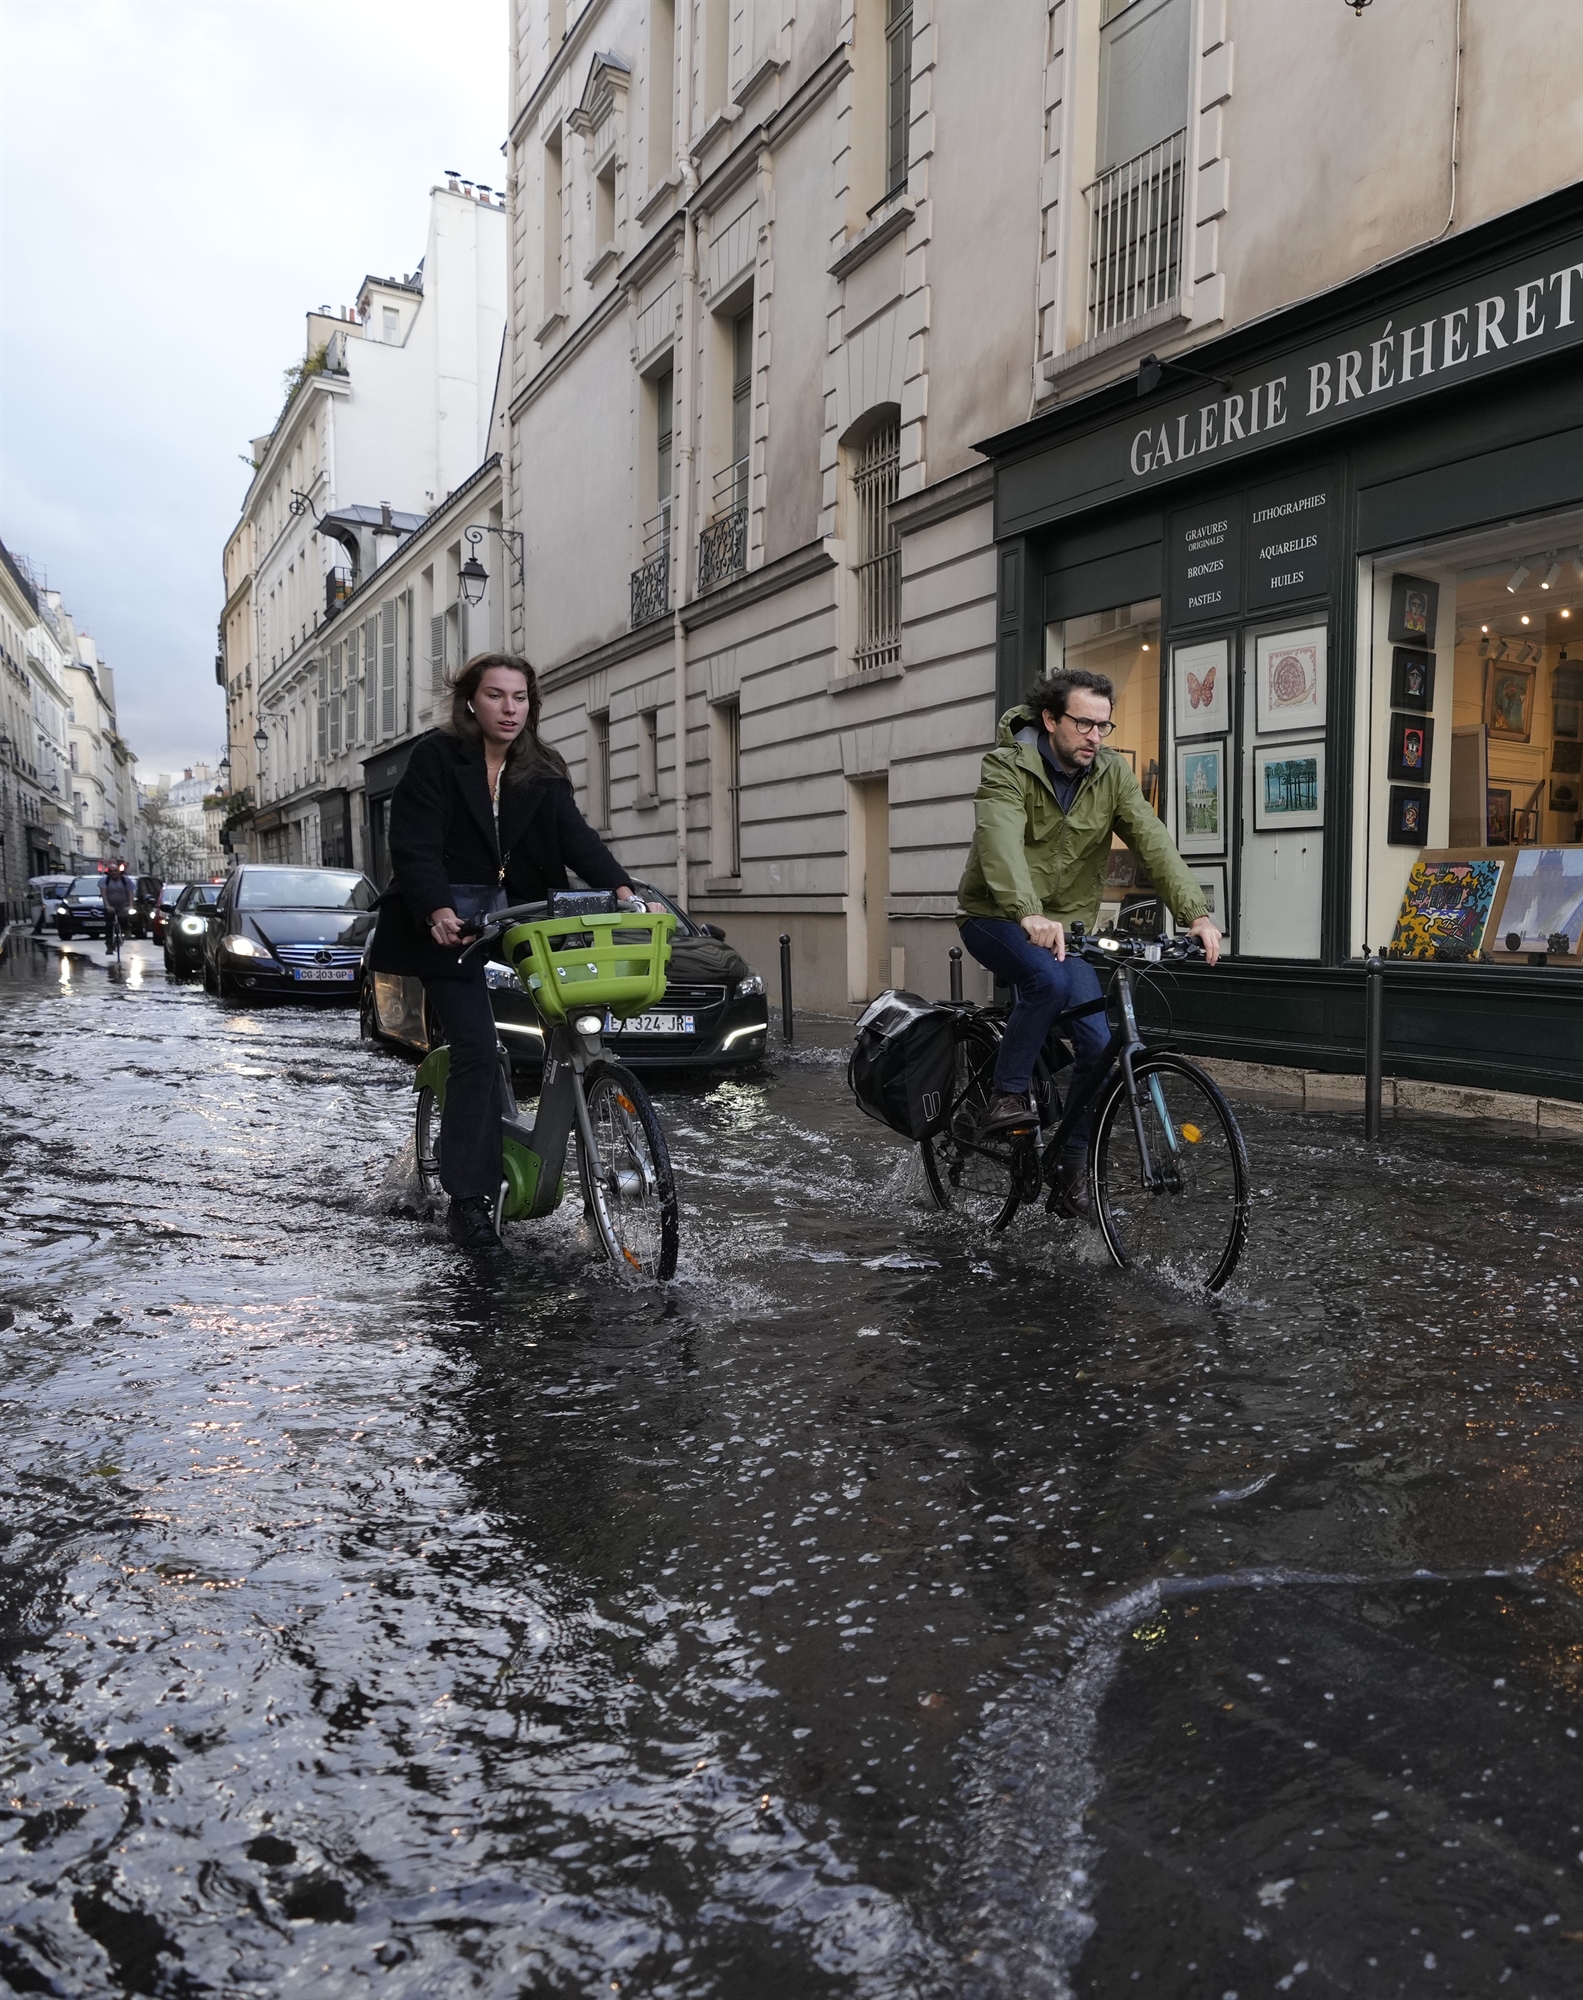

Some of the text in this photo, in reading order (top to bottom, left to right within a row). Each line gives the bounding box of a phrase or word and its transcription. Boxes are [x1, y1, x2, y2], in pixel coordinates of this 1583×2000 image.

[1130, 262, 1583, 476] GALERIE BRÉHERET
[1252, 493, 1326, 524] LITHOGRAPHIES
[1185, 520, 1228, 541] GRAVURES
[1188, 535, 1225, 552] ORIGINALES
[1259, 535, 1318, 560] AQUARELLES
[1187, 559, 1224, 578] BRONZES
[1270, 571, 1304, 588] HUILES
[1188, 591, 1222, 608] PASTELS
